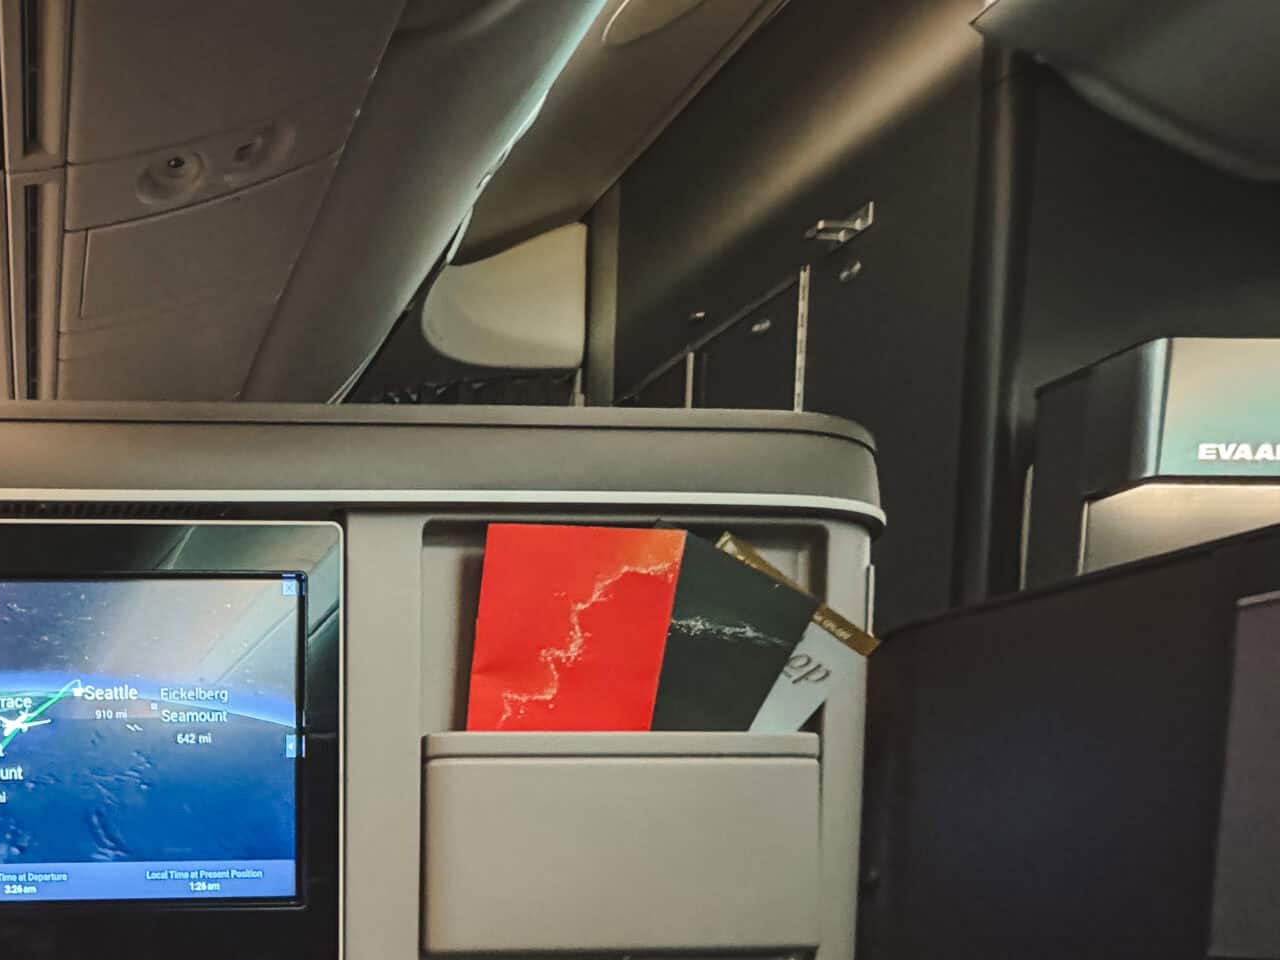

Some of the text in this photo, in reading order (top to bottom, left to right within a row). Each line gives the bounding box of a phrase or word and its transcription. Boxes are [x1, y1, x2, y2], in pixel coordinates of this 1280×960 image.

[783, 653, 831, 685] op
[84, 684, 138, 701] Seattle
[160, 687, 229, 703] Eickelberg
[95, 709, 128, 720] 910 mi
[161, 709, 228, 723] Seamount
[176, 733, 212, 745] 642 mi
[146, 870, 168, 880] Local
[169, 870, 189, 880] Time
